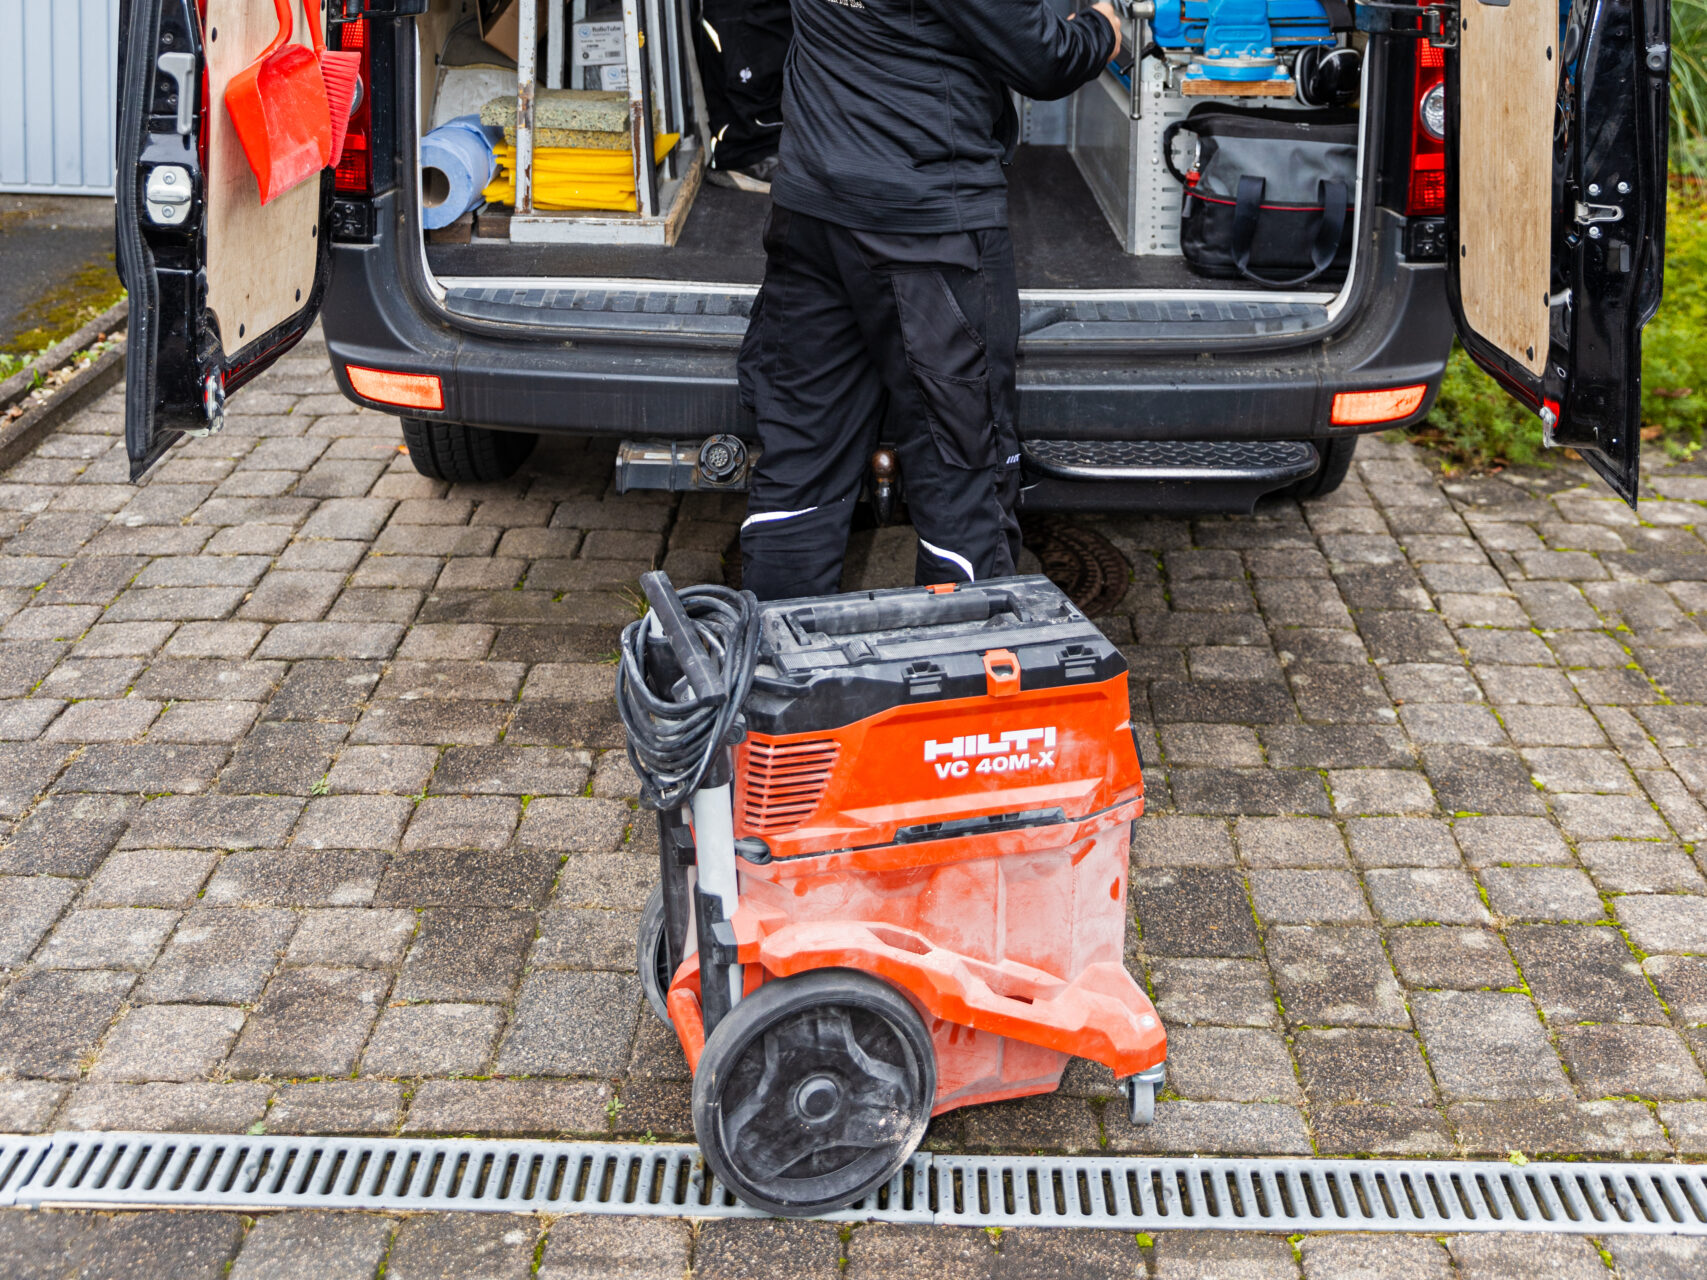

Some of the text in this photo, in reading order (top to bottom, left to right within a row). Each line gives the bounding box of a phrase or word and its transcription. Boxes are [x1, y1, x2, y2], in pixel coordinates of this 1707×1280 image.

[924, 726, 1057, 762] HILTI
[934, 750, 1055, 779] VC 40M-X
